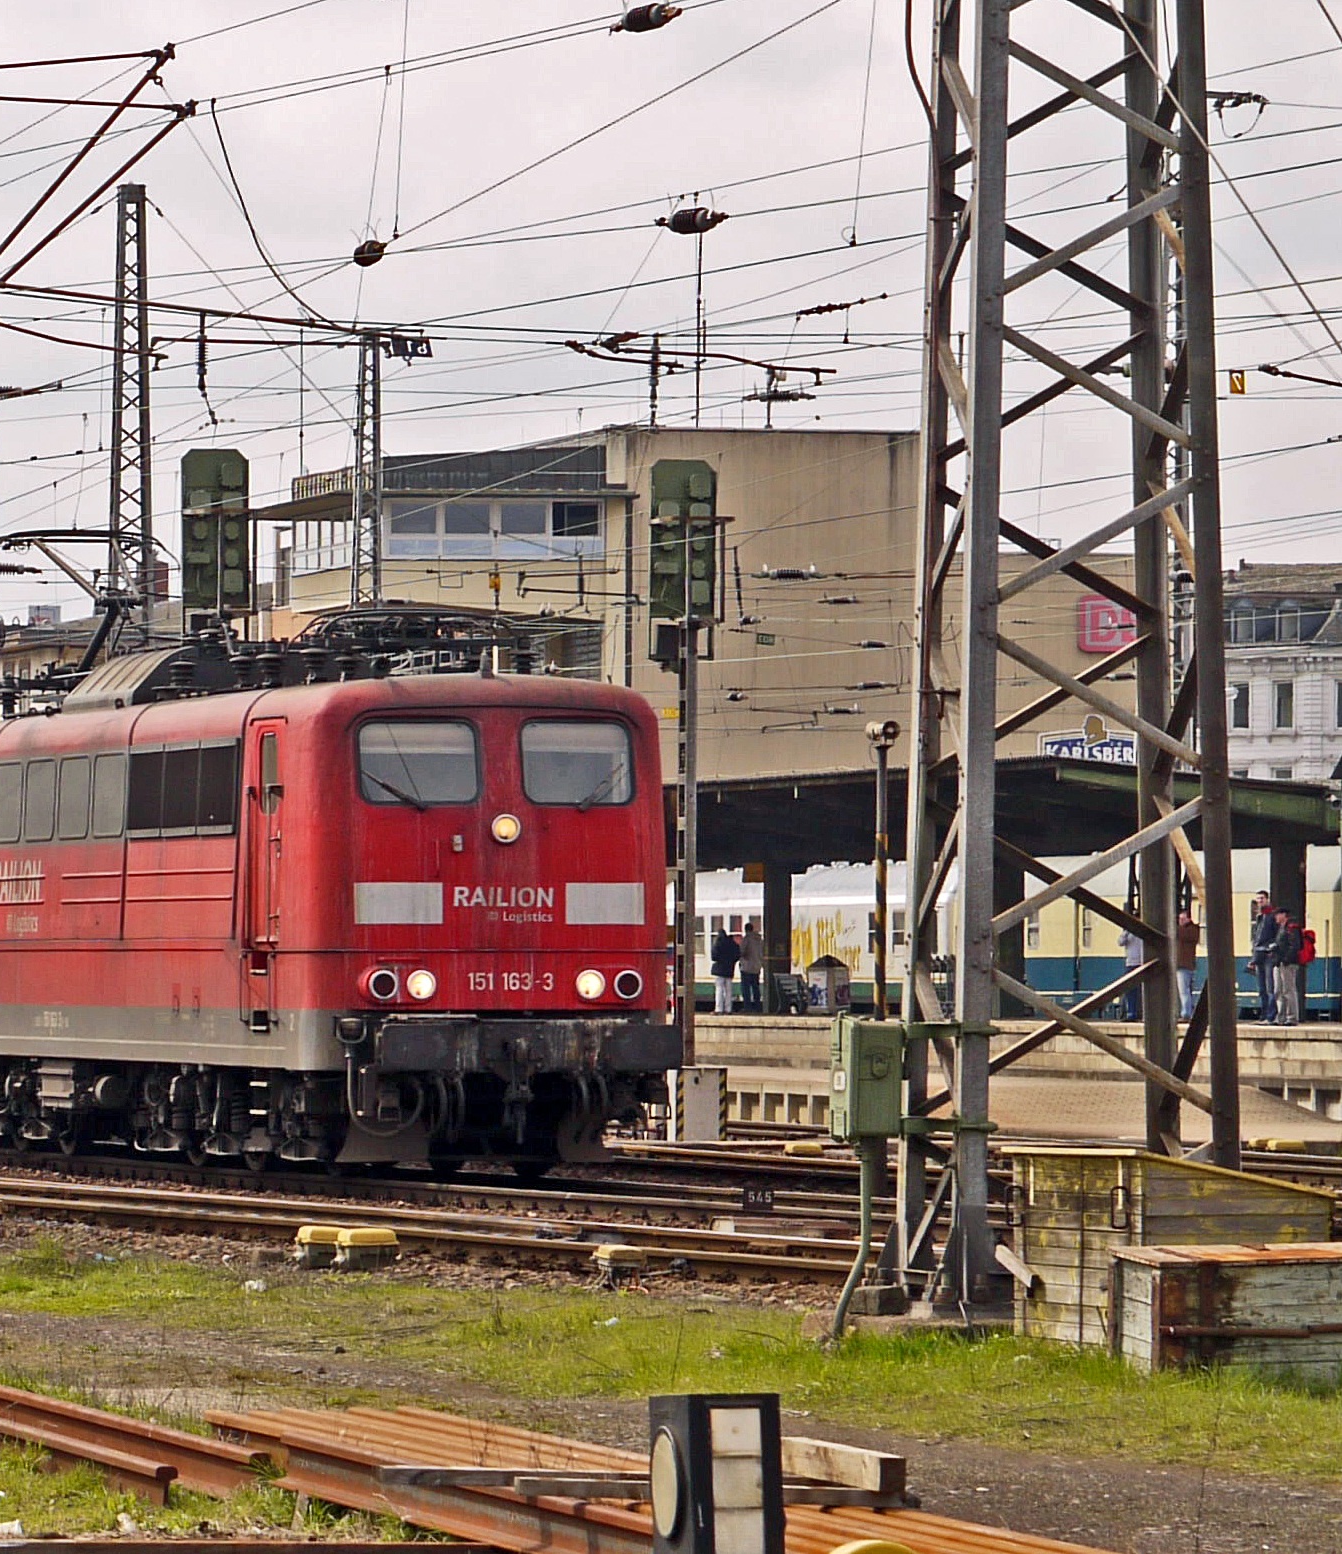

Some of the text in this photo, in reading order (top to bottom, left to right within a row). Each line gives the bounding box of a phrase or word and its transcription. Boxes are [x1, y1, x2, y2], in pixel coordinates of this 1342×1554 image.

[1045, 743, 1134, 763] KARLSBER
[453, 886, 555, 908] RAILION
[503, 911, 554, 924] Logistics
[467, 972, 554, 991] 151 163-3
